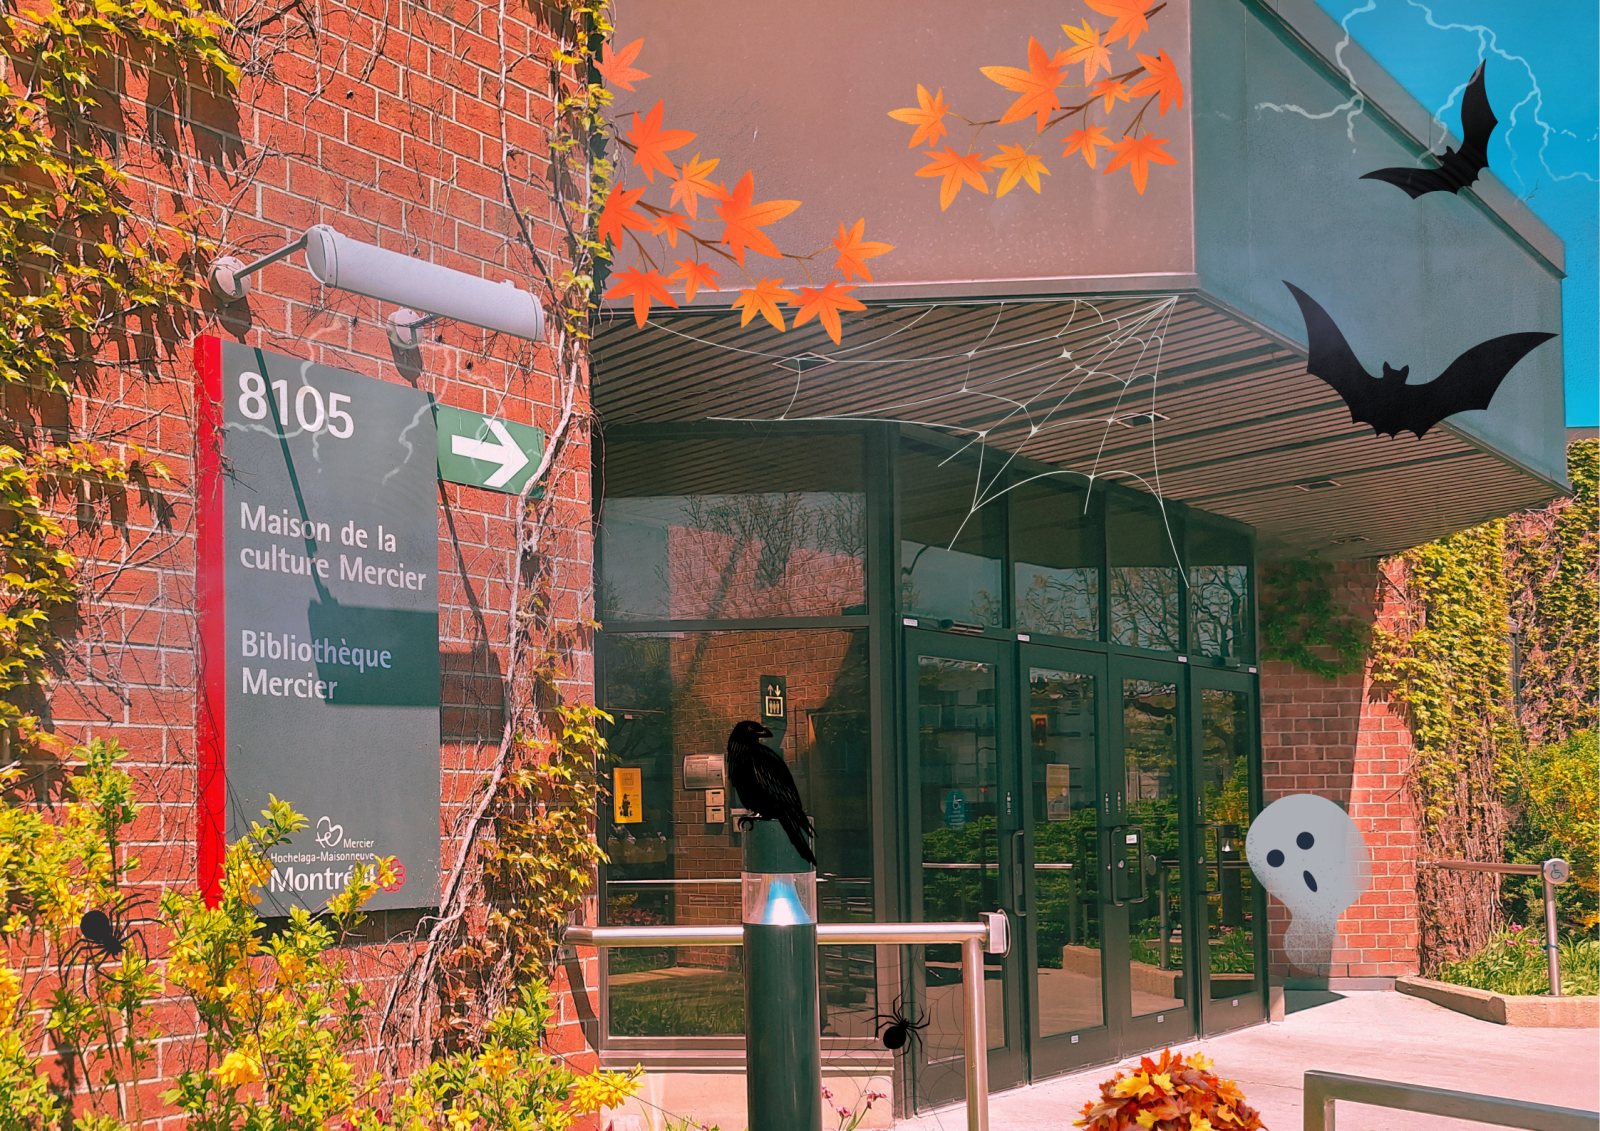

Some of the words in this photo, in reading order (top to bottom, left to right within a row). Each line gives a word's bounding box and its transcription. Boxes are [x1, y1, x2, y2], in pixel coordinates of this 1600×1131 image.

[238, 372, 354, 439] 8105
[240, 501, 330, 543] Maison
[340, 520, 368, 549] de
[378, 525, 397, 553] la
[240, 544, 329, 578] culture
[340, 555, 427, 591] Mercier
[242, 630, 392, 673] Bibliothèque
[242, 667, 338, 699] Mercier
[270, 851, 374, 864] Hochelaga-Maisonneuve
[343, 838, 374, 848] Mercier
[271, 865, 375, 892] Montrél
